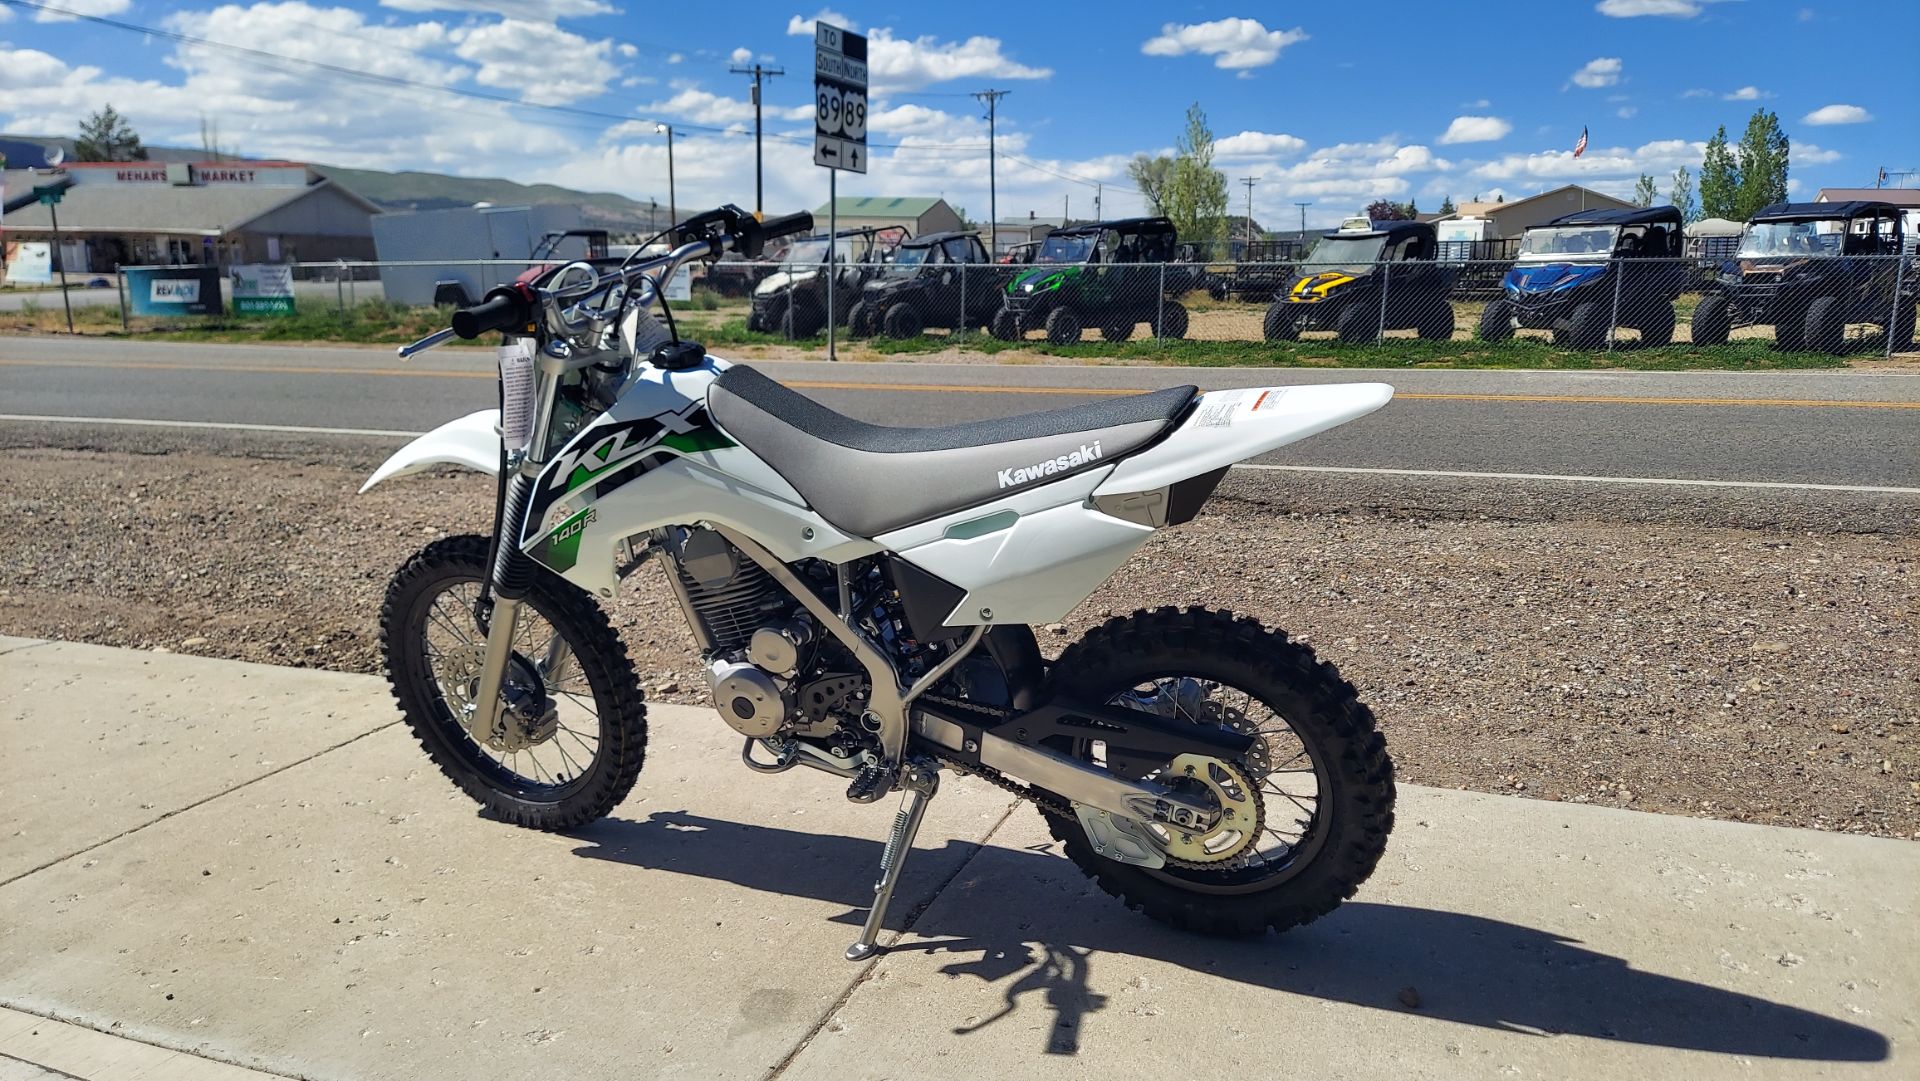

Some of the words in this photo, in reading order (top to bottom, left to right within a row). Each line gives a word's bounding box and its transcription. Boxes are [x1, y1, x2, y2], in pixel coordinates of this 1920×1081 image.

[823, 29, 837, 46] TO
[817, 53, 842, 76] SOUTH
[844, 59, 867, 82] NORTH
[819, 93, 840, 122] 89
[845, 101, 865, 128] 89
[201, 170, 256, 181] MARKET
[548, 398, 706, 490] KLX
[997, 440, 1103, 489] Kawasaki
